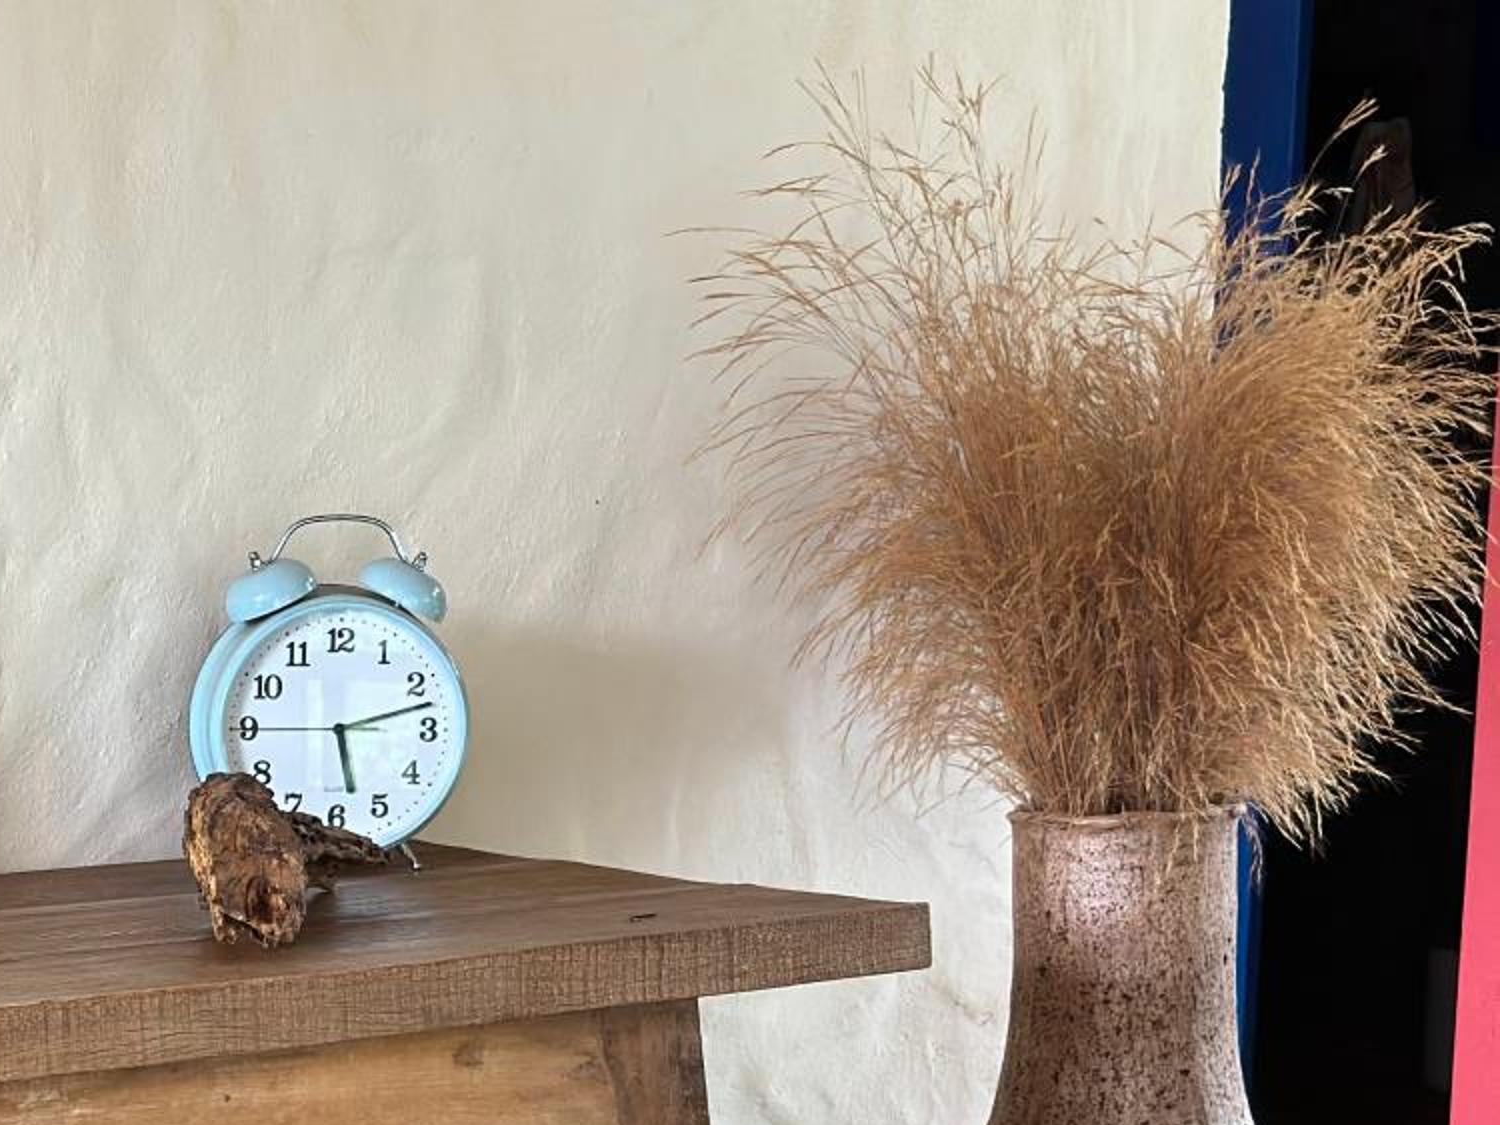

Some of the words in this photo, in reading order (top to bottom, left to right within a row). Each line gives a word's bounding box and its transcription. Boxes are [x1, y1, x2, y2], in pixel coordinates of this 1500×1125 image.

[326, 627, 356, 653] 12
[377, 639, 391, 665] 1
[285, 640, 311, 667] 11
[253, 673, 283, 700] 10
[407, 671, 426, 697] 2
[239, 715, 259, 741] 9
[419, 717, 438, 742] 3
[253, 760, 272, 785] 8
[401, 760, 421, 785] 4
[284, 792, 303, 813] 7
[371, 793, 389, 818] 5
[327, 803, 346, 828] 6
